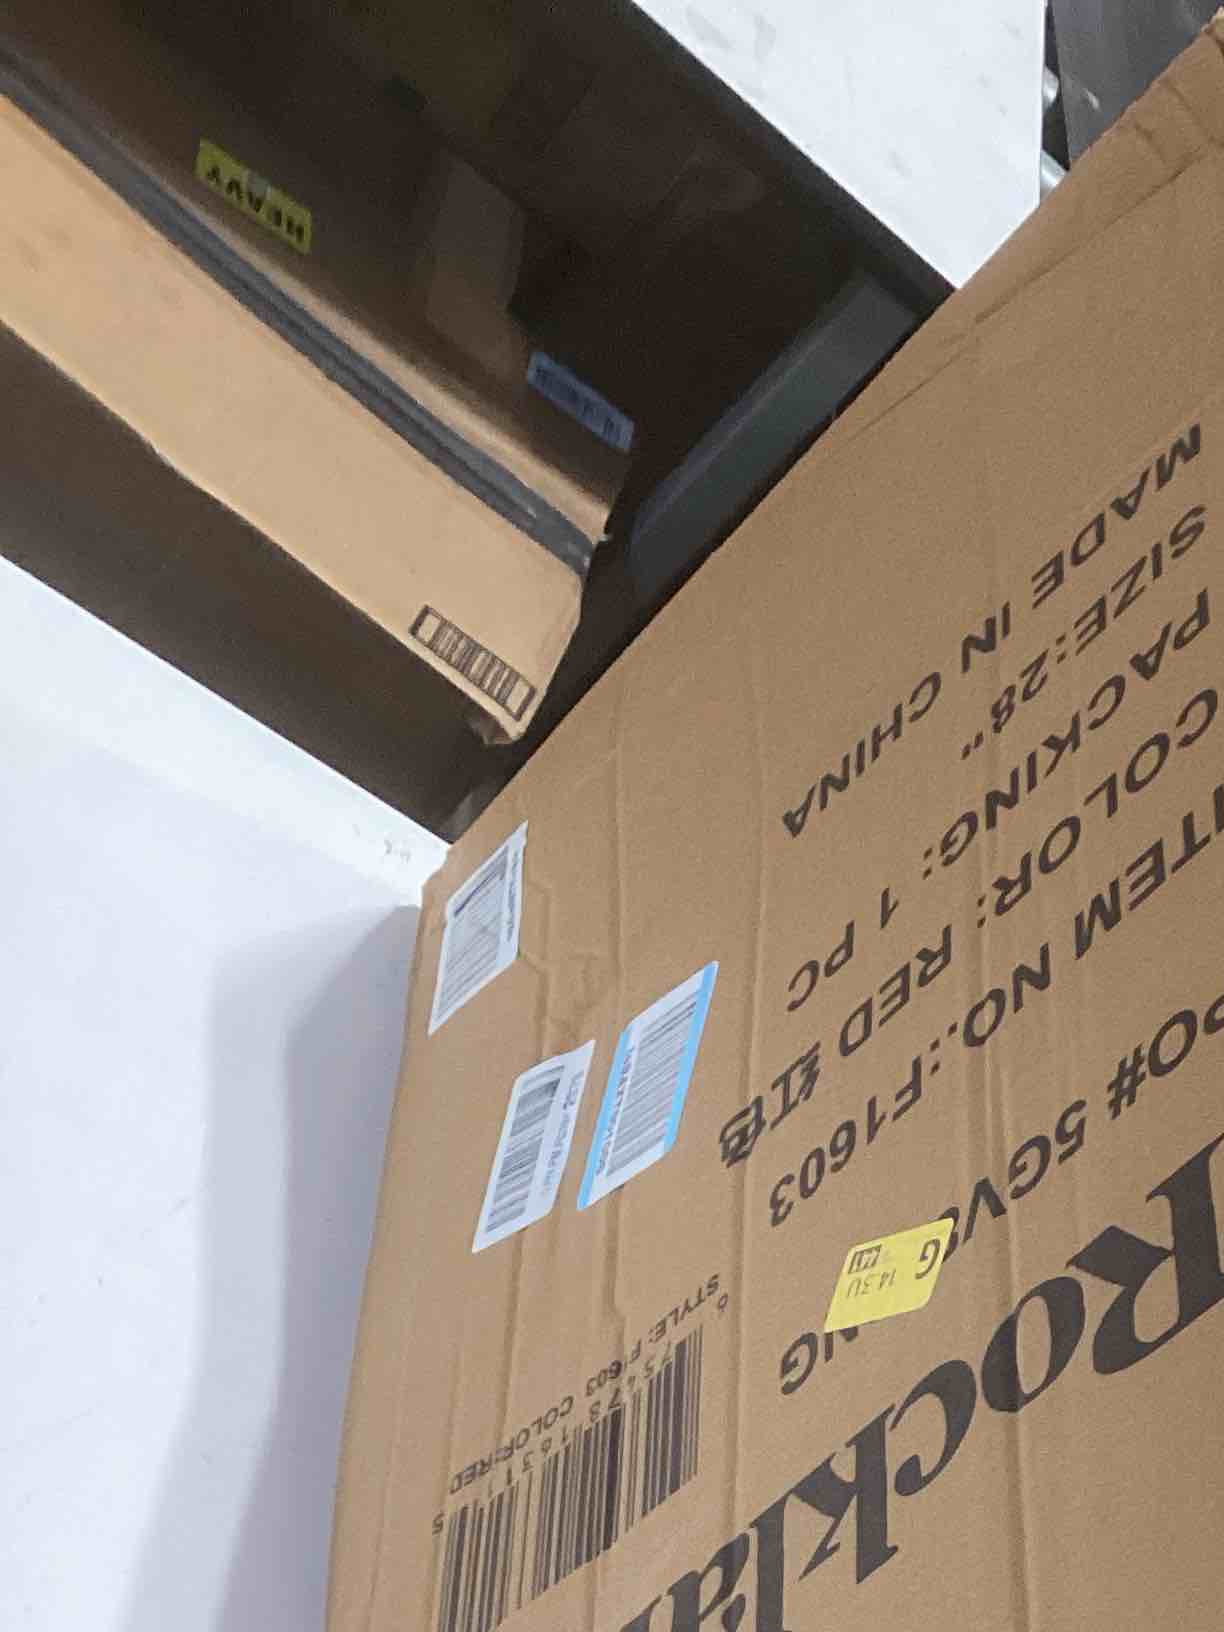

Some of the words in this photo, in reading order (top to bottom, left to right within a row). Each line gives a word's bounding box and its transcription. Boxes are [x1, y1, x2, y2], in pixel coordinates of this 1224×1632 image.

[1031, 423, 1201, 610] MADE
[960, 504, 1207, 761] SIZE:28"
[961, 600, 1011, 674] IN
[782, 671, 942, 839] CHINA
[922, 587, 1212, 880] PACKING:
[976, 688, 1219, 928] COLOR:
[786, 920, 856, 1013] PC
[879, 886, 900, 929] 1
[839, 924, 953, 1057] RED
[769, 943, 1052, 1228] NO.:F1603
[648, 1272, 721, 1345] STYLE:
[915, 1238, 941, 1280] G
